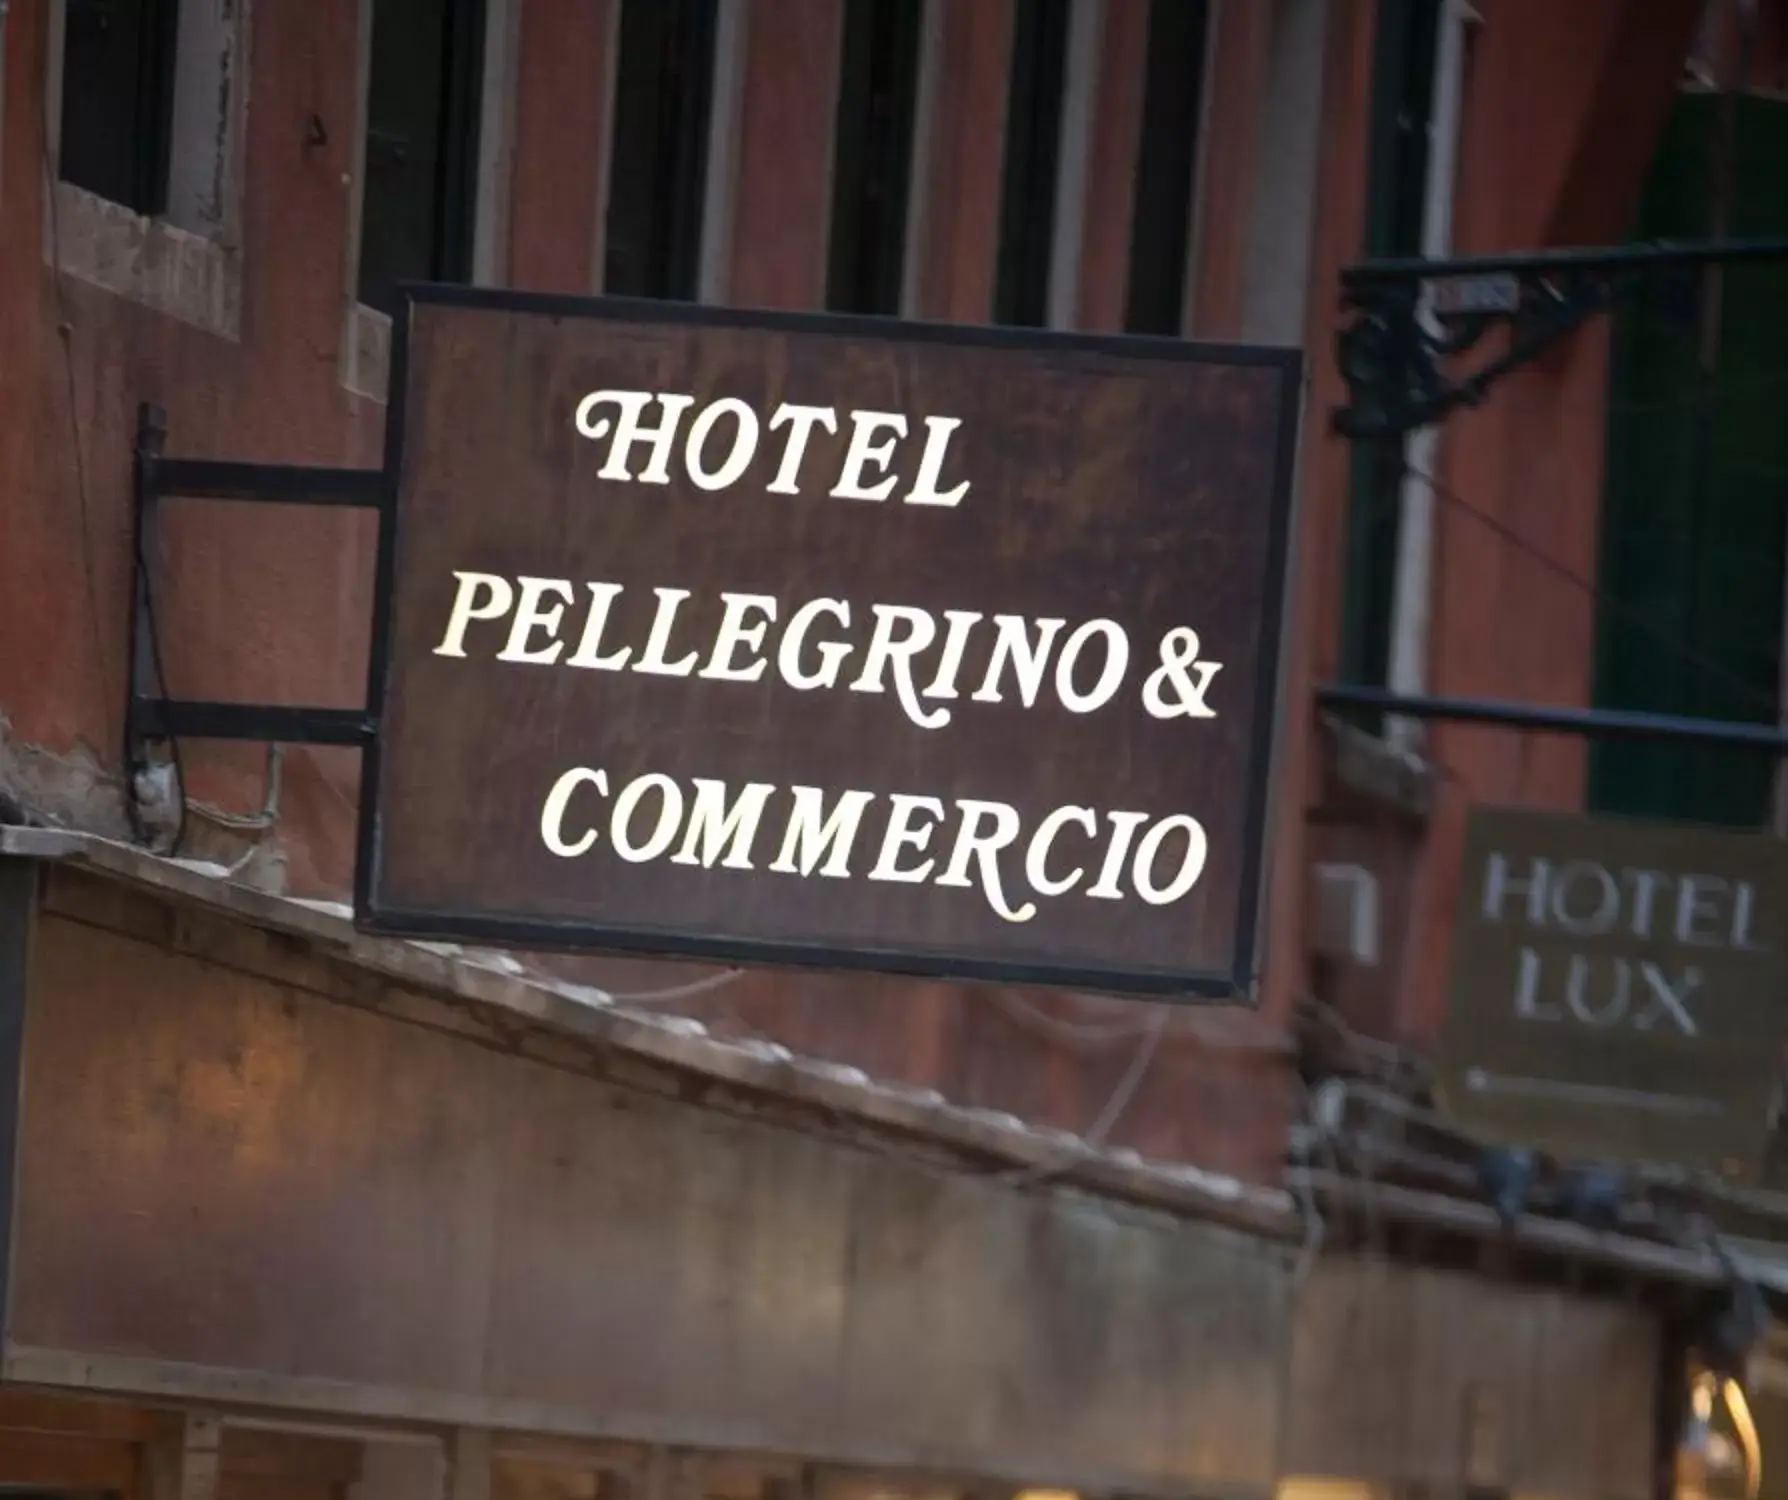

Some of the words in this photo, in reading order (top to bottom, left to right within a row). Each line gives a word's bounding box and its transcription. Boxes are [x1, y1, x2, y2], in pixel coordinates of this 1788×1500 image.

[575, 389, 971, 507] HOTEL
[432, 571, 1129, 728] PELLEGRINO
[1141, 626, 1223, 719] &
[541, 767, 1207, 923] COMMERCIO
[1481, 850, 1771, 951] HOTEL
[1514, 945, 1702, 1036] LUX
